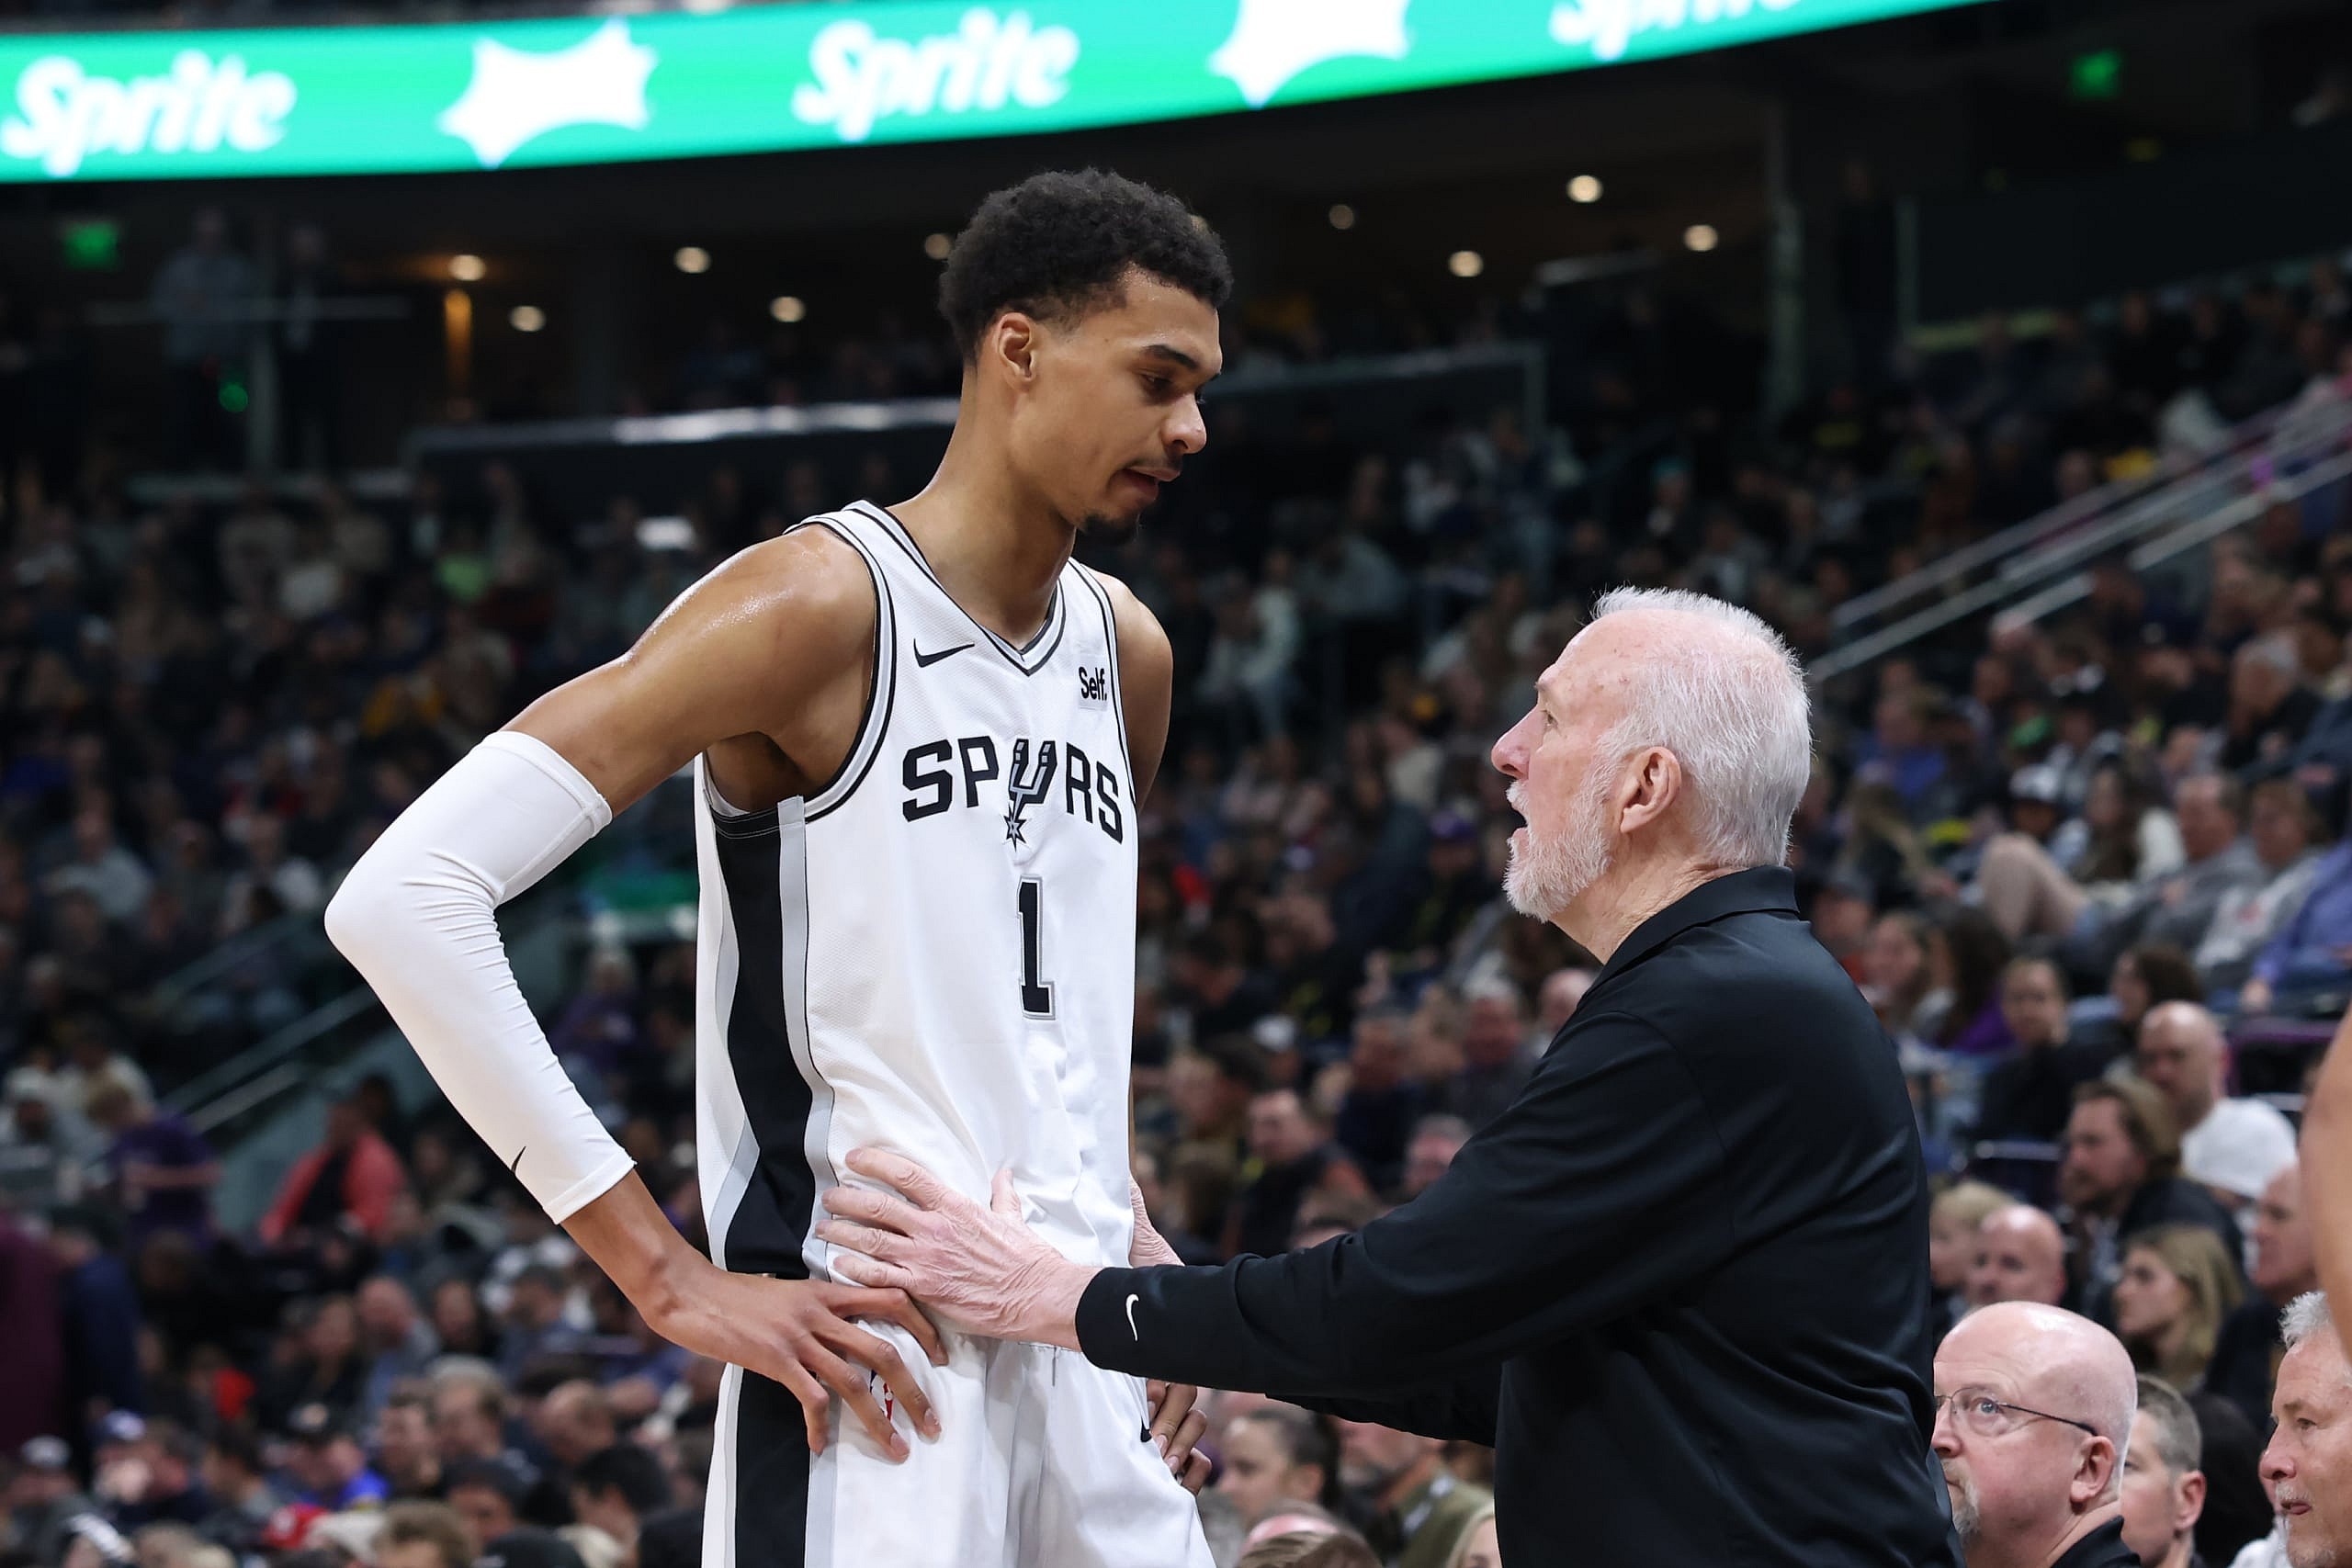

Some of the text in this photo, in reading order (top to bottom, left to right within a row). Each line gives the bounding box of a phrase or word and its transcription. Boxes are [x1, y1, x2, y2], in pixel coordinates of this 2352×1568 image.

[0, 52, 296, 175] Sprite
[793, 9, 1080, 141] Sprite
[902, 735, 1124, 849] SPURS
[1016, 875, 1056, 1021] 1
